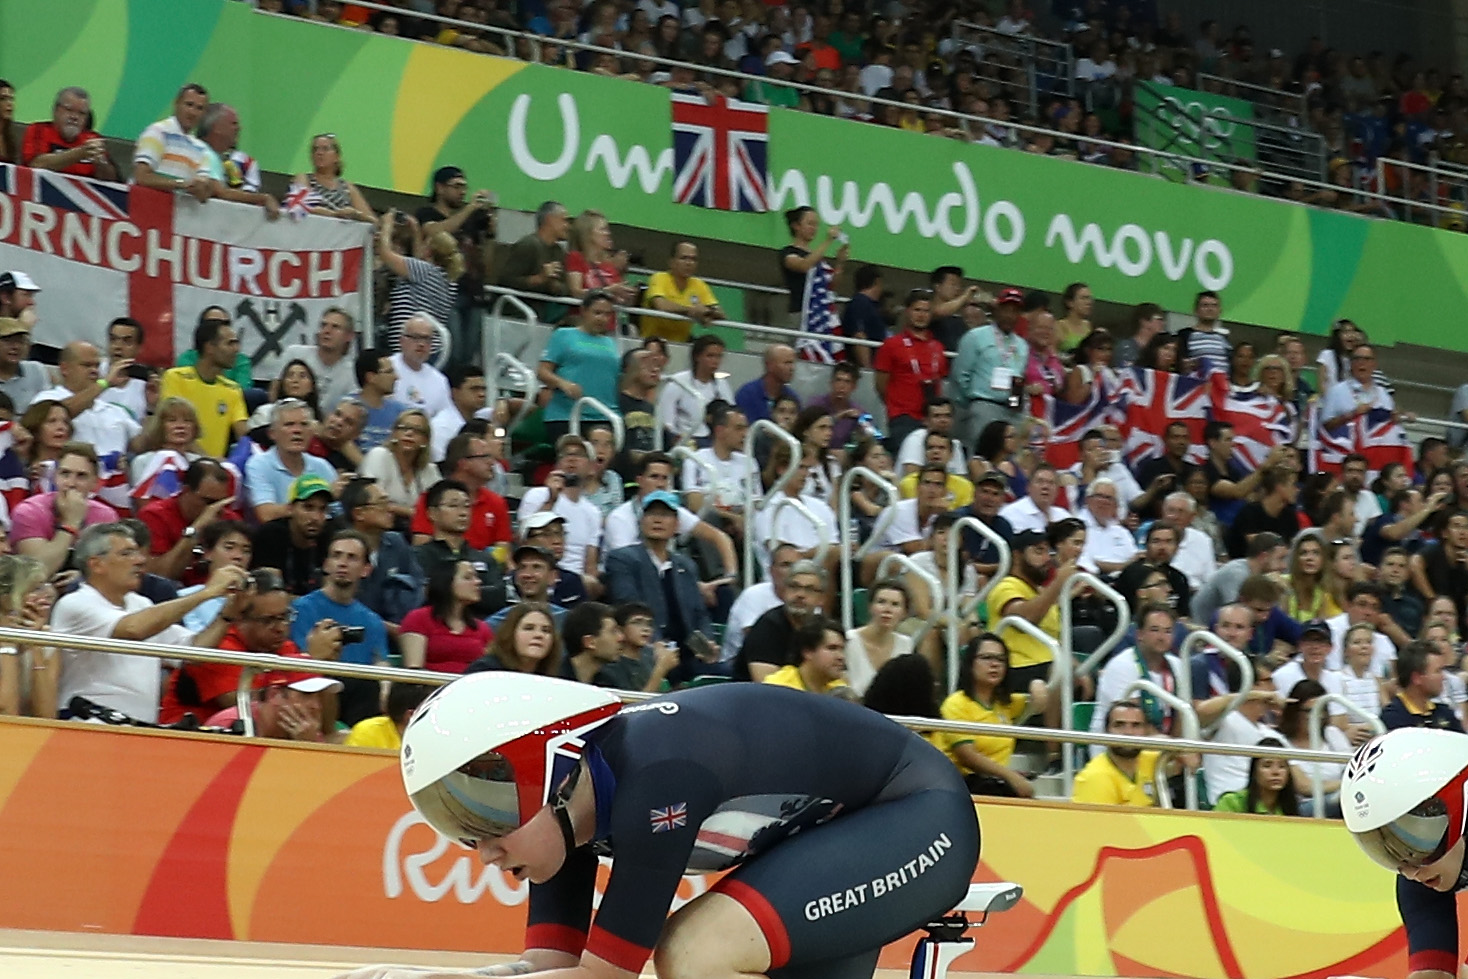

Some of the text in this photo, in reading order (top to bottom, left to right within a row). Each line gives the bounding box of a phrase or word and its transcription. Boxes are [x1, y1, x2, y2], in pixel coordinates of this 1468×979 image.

[1045, 212, 1234, 292] novo
[804, 832, 953, 921] GREAT BRITAIN
